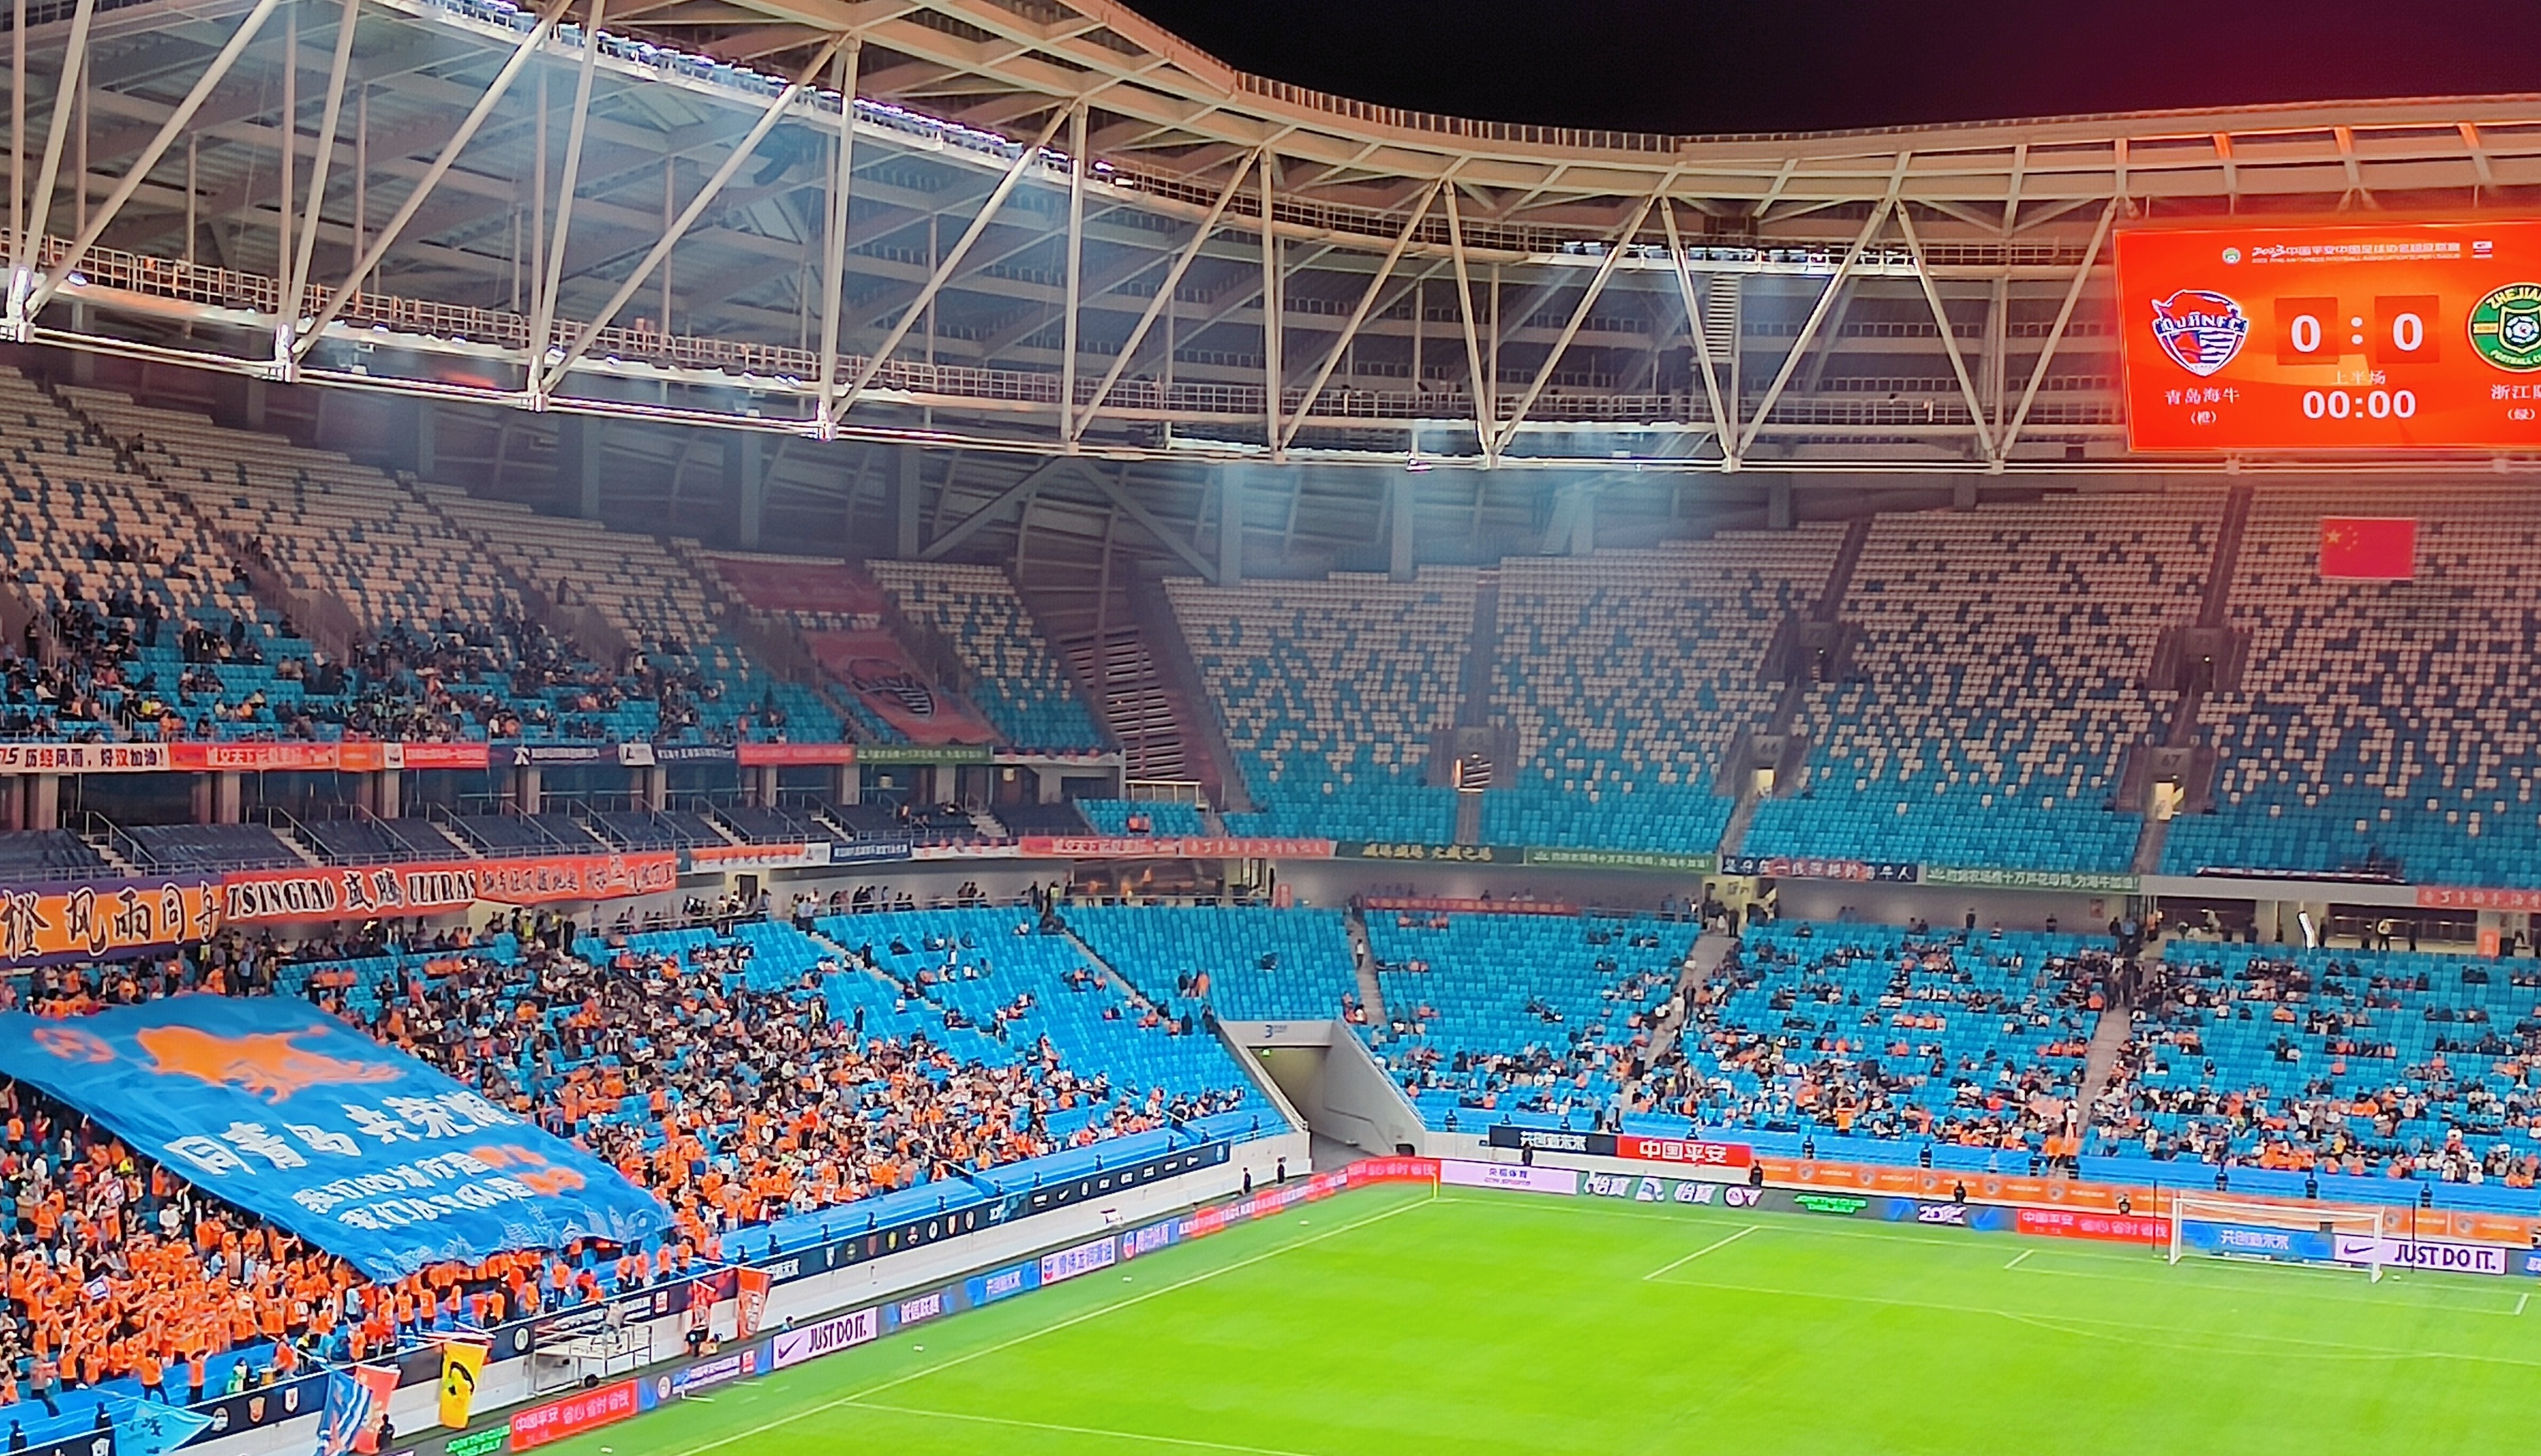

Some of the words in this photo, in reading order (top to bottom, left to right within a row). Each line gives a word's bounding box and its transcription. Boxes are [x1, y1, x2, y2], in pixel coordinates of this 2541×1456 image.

[2485, 287, 2541, 309] ZHEJIA
[2291, 315, 2321, 353] 0
[2392, 313, 2423, 351] 0
[2331, 370, 2386, 385] 上半场
[2165, 387, 2239, 406] 青岛海牛
[2303, 390, 2416, 419] 00:00
[226, 878, 336, 920] TSINGTAO
[406, 869, 477, 906] ULTRAS
[1265, 1025, 1274, 1038] 3
[1638, 1139, 1727, 1164] 中国平安
[2022, 1211, 2074, 1226] 中国平安
[2395, 1244, 2439, 1265] JUST
[2443, 1247, 2470, 1267] DO
[2476, 1251, 2496, 1270] IT.
[808, 1322, 835, 1353] JUST
[836, 1318, 853, 1345] DO
[855, 1314, 867, 1339] IT.
[515, 1406, 559, 1432] 中国平安
